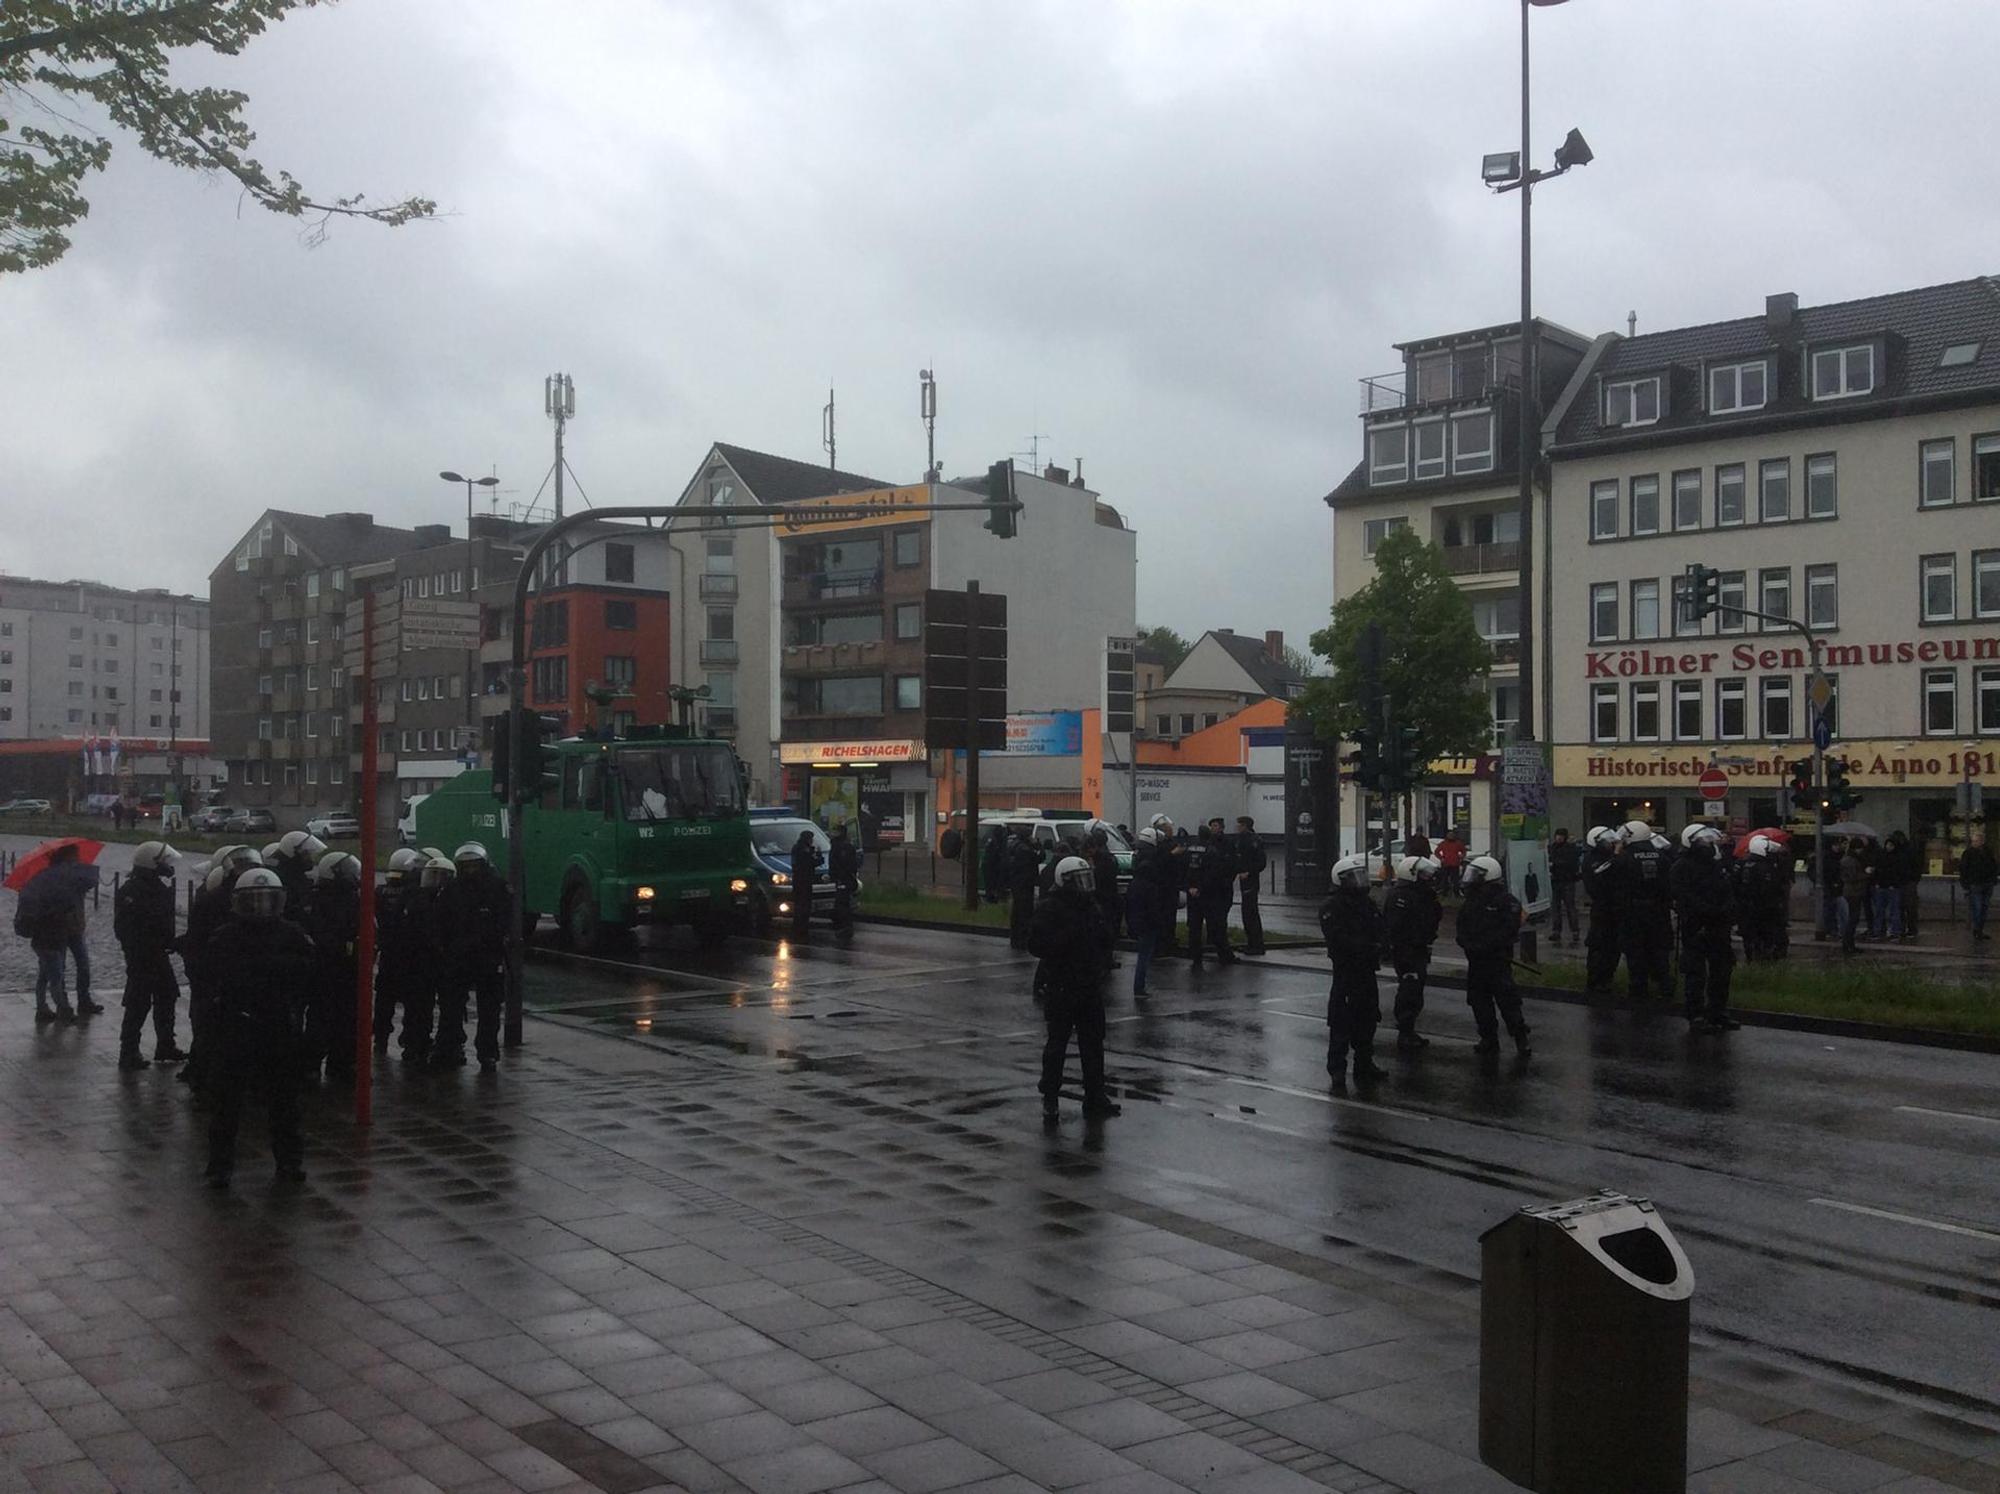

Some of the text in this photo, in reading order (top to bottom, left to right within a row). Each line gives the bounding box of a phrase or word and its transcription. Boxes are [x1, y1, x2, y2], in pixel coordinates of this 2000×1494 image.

[1585, 637, 2000, 679] Kölner Senfmuseum
[822, 745, 909, 757] RICHELSHAGEN
[1587, 757, 1719, 778] Historisch
[1728, 755, 1862, 777] Senfme
[1868, 754, 1941, 776] Anno
[1947, 751, 2000, 776] 181
[638, 827, 655, 838] W2
